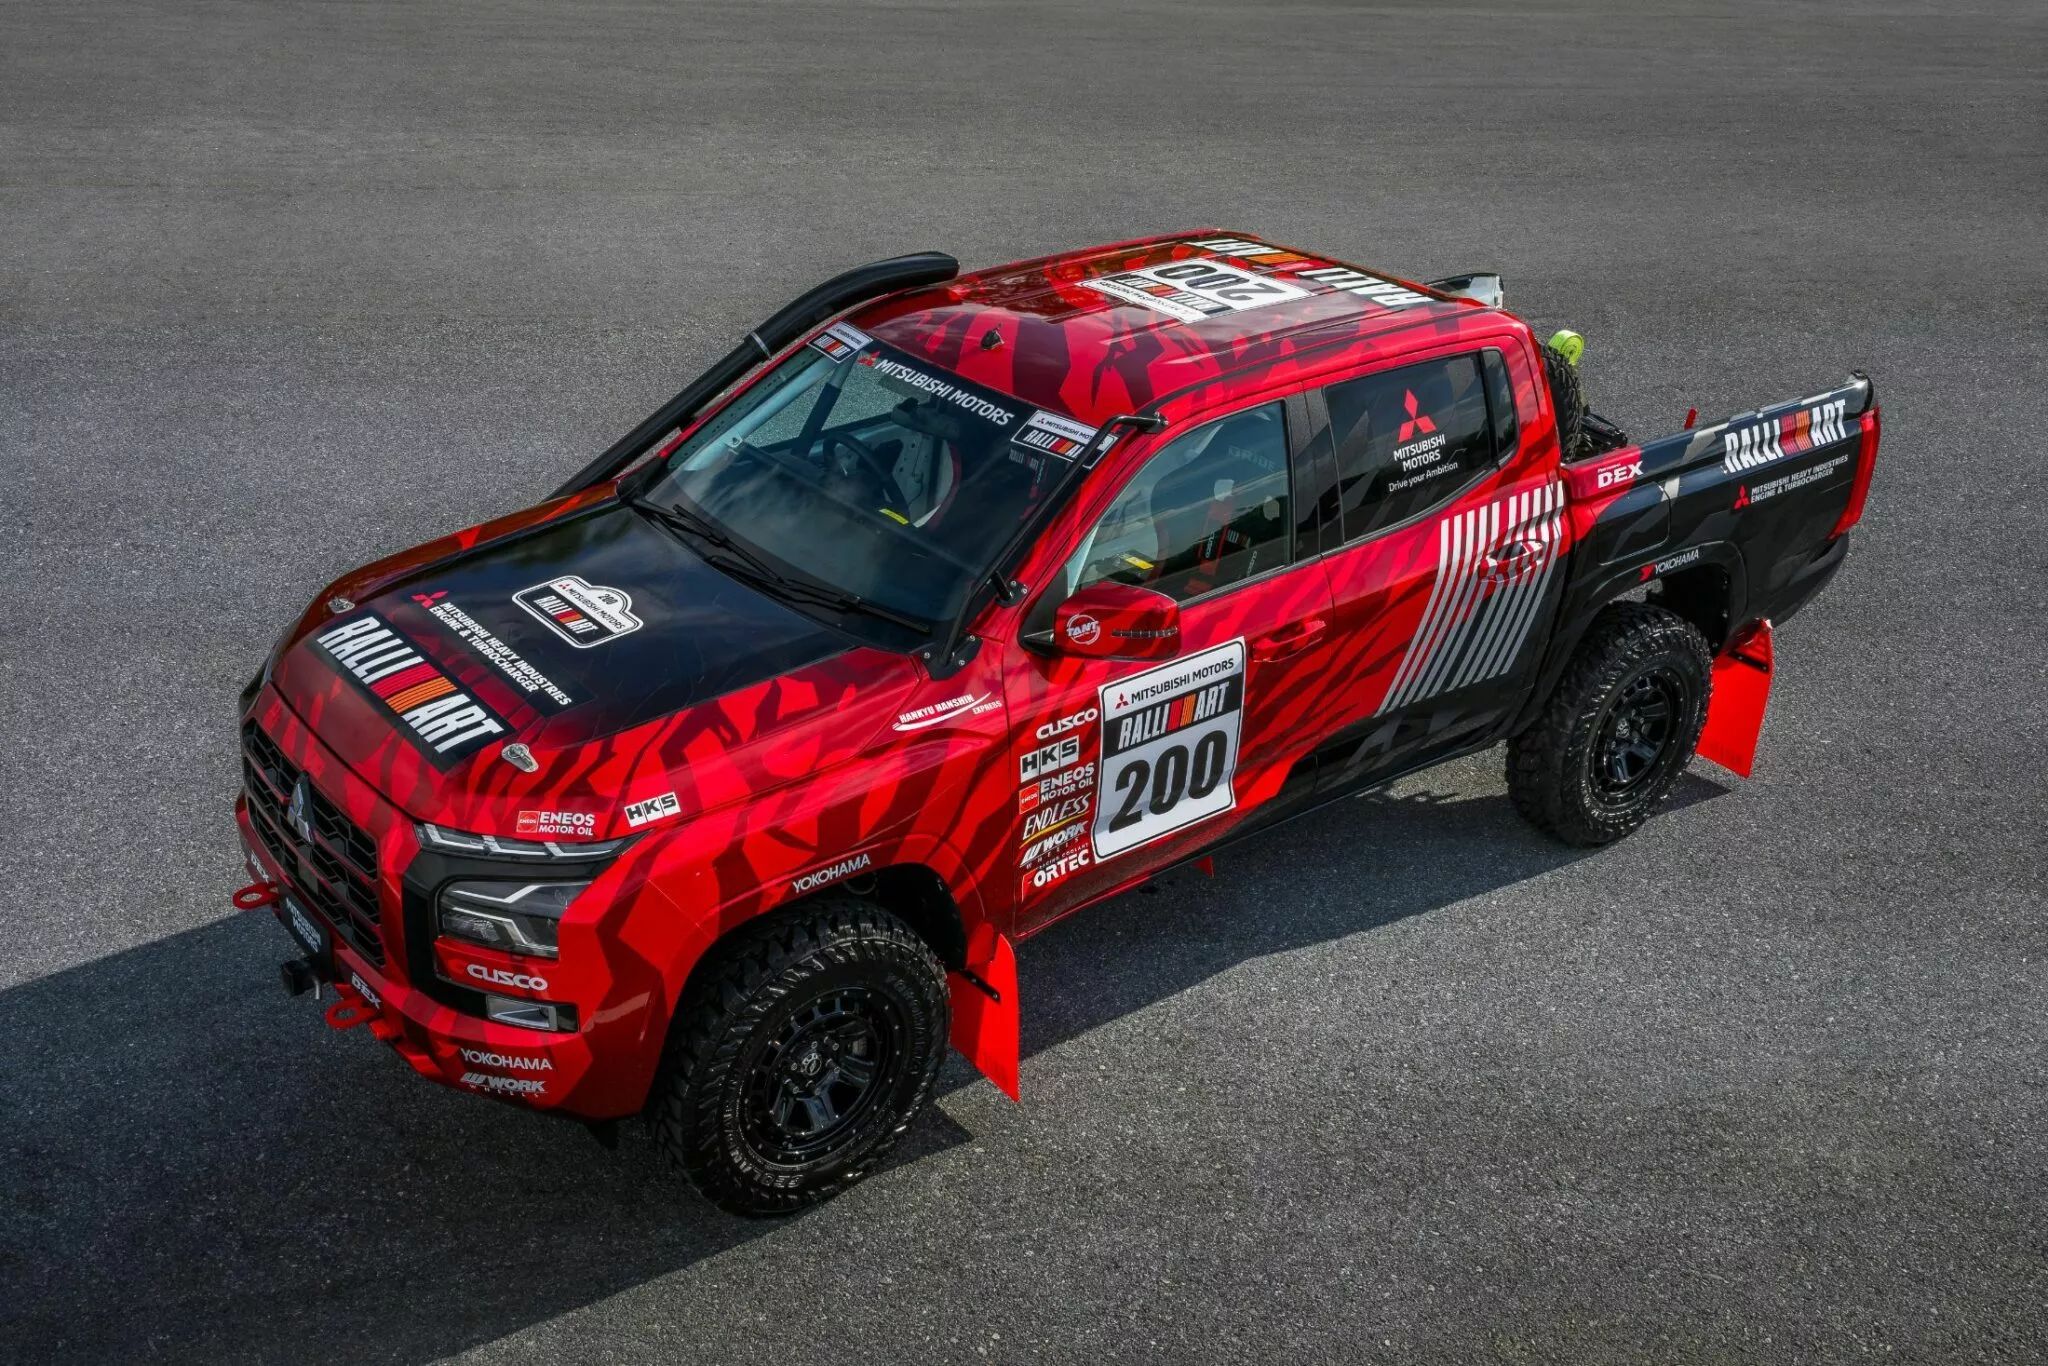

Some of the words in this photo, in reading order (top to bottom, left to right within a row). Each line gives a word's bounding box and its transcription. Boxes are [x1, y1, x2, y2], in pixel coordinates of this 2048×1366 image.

[1153, 264, 1287, 300] 200
[874, 359, 950, 397] MITSUBISHI
[947, 389, 1015, 426] MOTORS
[1046, 421, 1080, 437] MITSUBISHI
[1393, 434, 1446, 461] MITSUBISHI
[1403, 450, 1441, 472] MOTORS
[1388, 476, 1408, 492] Drive
[1409, 473, 1425, 487] your
[1426, 461, 1458, 478] Ambition
[1598, 461, 1643, 488] DEX
[1751, 477, 1790, 495] MITSUBISHI
[1791, 469, 1812, 481] HEAVY
[1813, 454, 1848, 475] INDUSTRIES
[1750, 490, 1776, 503] ENGINE
[1654, 549, 1699, 575] YOKOHAMA
[568, 588, 600, 613] MITSUBISHI
[599, 610, 625, 629] MOTORS
[598, 594, 618, 605] 200
[429, 607, 462, 631] ENGINE
[459, 628, 471, 638] &
[467, 636, 539, 692] TURBOCHARGER
[439, 602, 491, 639] MITSUBISHI
[486, 637, 521, 661] HEAVY
[514, 659, 572, 705] INDUSTRIES
[1131, 674, 1190, 704] MITSUBISHI
[1192, 658, 1234, 681] MOTORS
[899, 705, 935, 724] HANKYU
[934, 694, 975, 712] HANSHIN
[972, 700, 1002, 715] EXPRESS
[1036, 708, 1098, 740] CUSCO
[1022, 737, 1078, 774] HKS
[1040, 762, 1095, 793] ENEOS
[1041, 784, 1076, 803] MOTOR
[1078, 777, 1094, 788] OIL
[1108, 730, 1227, 834] 200
[539, 811, 595, 826] ENEOS
[626, 794, 677, 820] HKS
[1022, 792, 1092, 840] ENDLESS
[539, 825, 574, 834] MOTOR
[577, 826, 594, 836] OIL
[792, 853, 871, 893] YOKOHAMA
[1034, 848, 1089, 887] ORTEC
[352, 974, 382, 1009] DEX
[467, 963, 548, 991] CUSCO
[460, 1047, 553, 1070] YOKOHAMA
